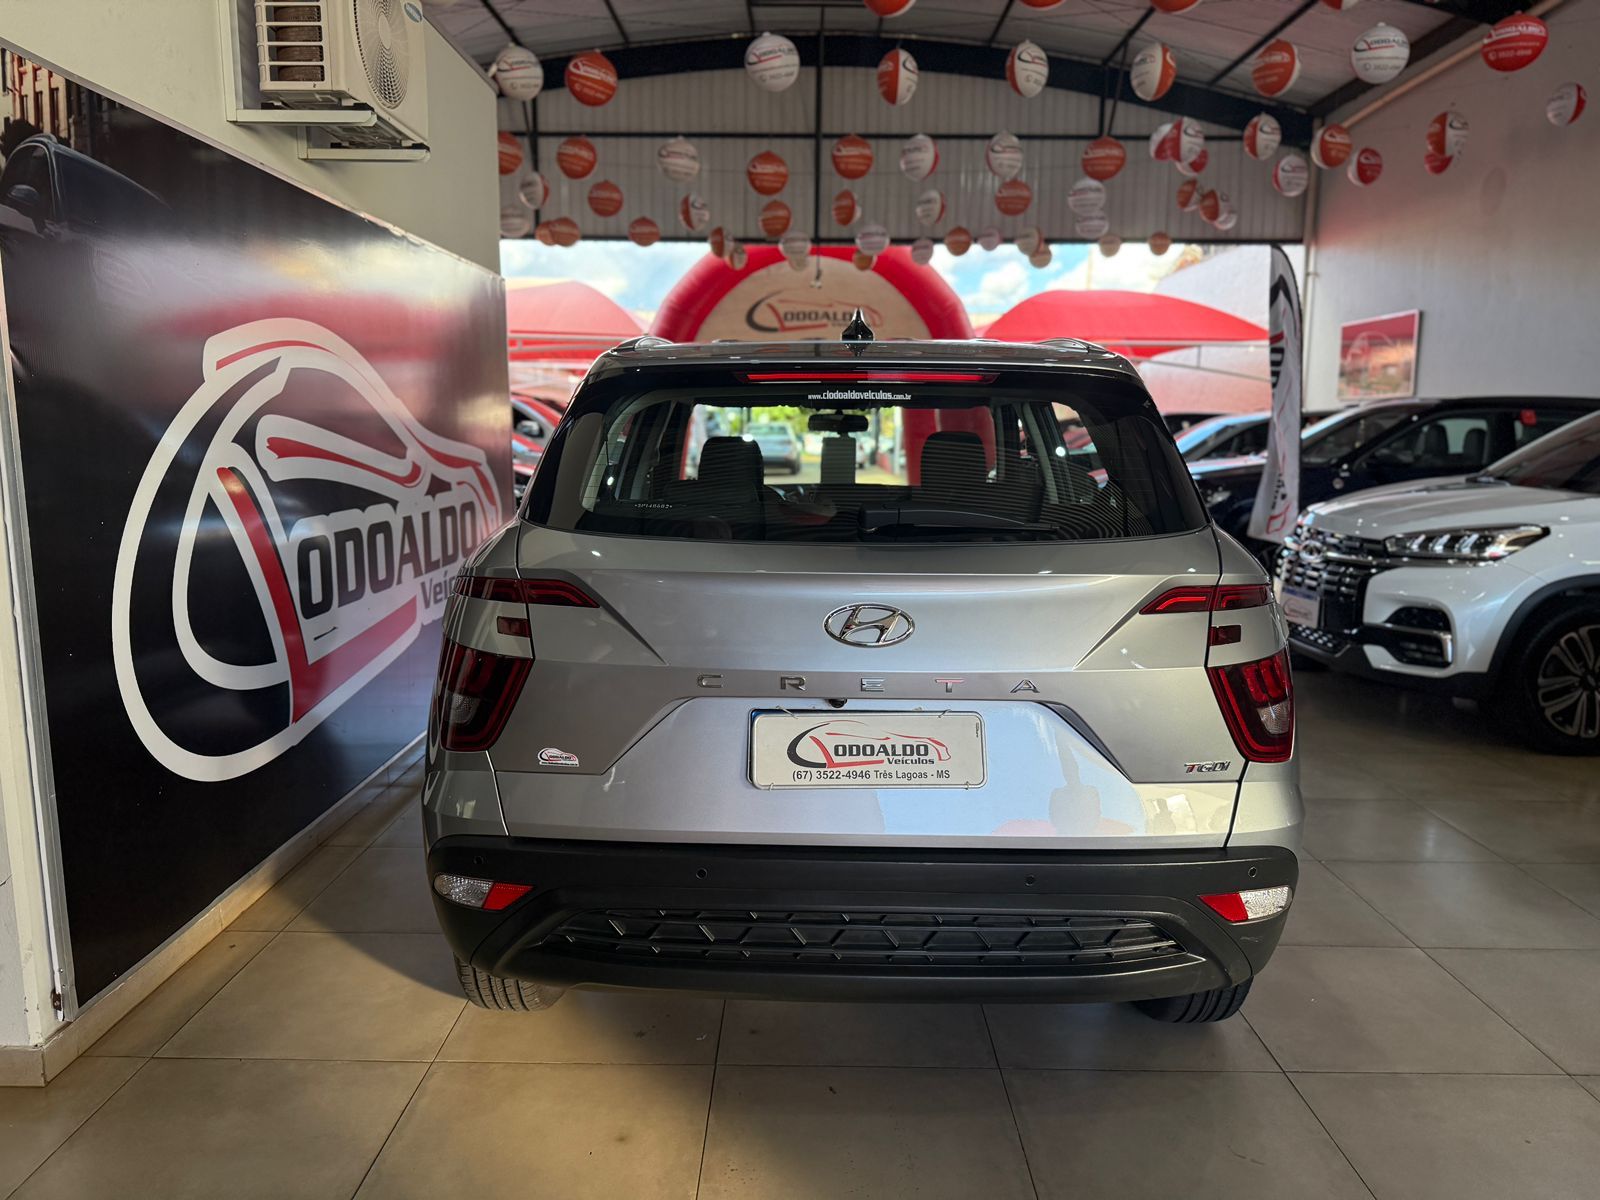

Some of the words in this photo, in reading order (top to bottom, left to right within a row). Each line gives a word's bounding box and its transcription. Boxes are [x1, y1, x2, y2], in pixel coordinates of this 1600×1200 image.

[698, 673, 1041, 693] CRETA
[887, 757, 935, 765] Veículos
[793, 770, 813, 782] (67)
[816, 770, 871, 780] 3522-4946
[874, 770, 893, 779] Três
[896, 770, 928, 781] Lagoas
[936, 770, 951, 779] MS
